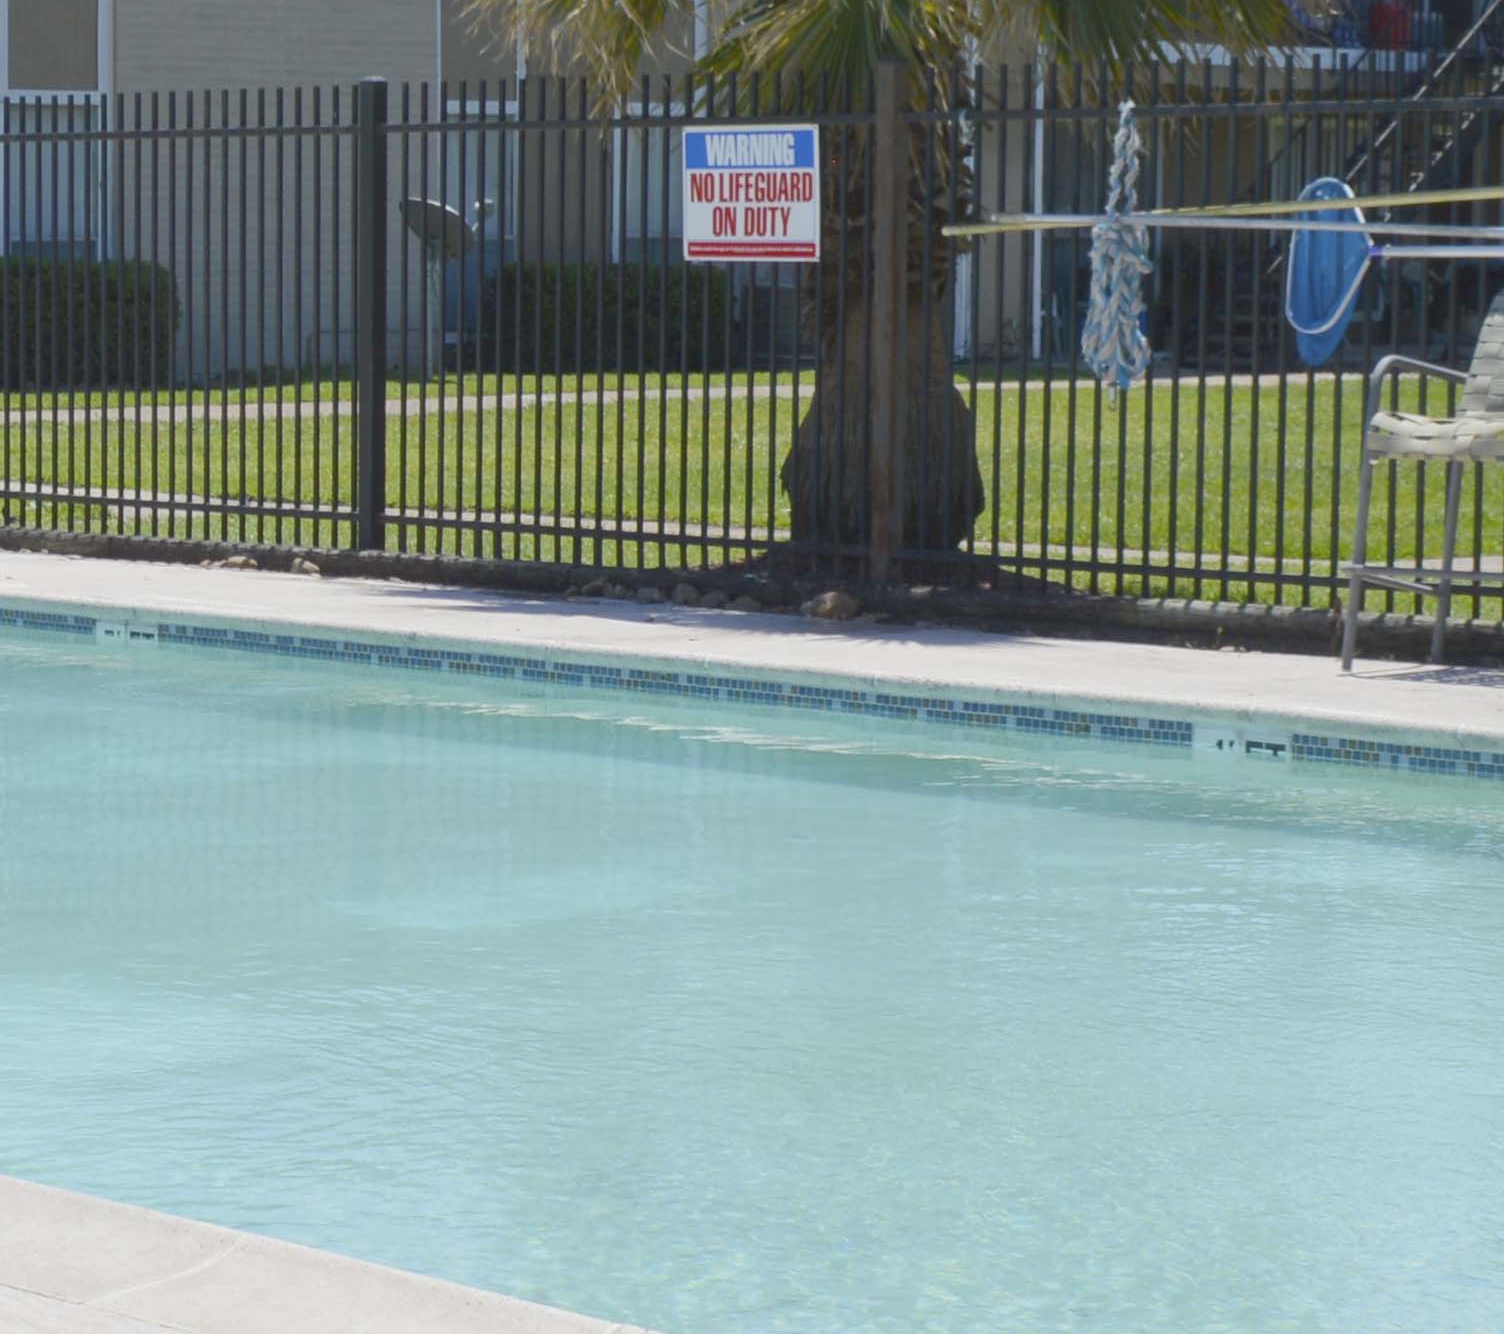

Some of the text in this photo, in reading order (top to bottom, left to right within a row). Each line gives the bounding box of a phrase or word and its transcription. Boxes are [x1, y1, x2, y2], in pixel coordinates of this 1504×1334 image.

[704, 132, 795, 167] WARNING
[690, 171, 814, 203] NO LIFEGUARD
[712, 206, 792, 238] ON DUTY
